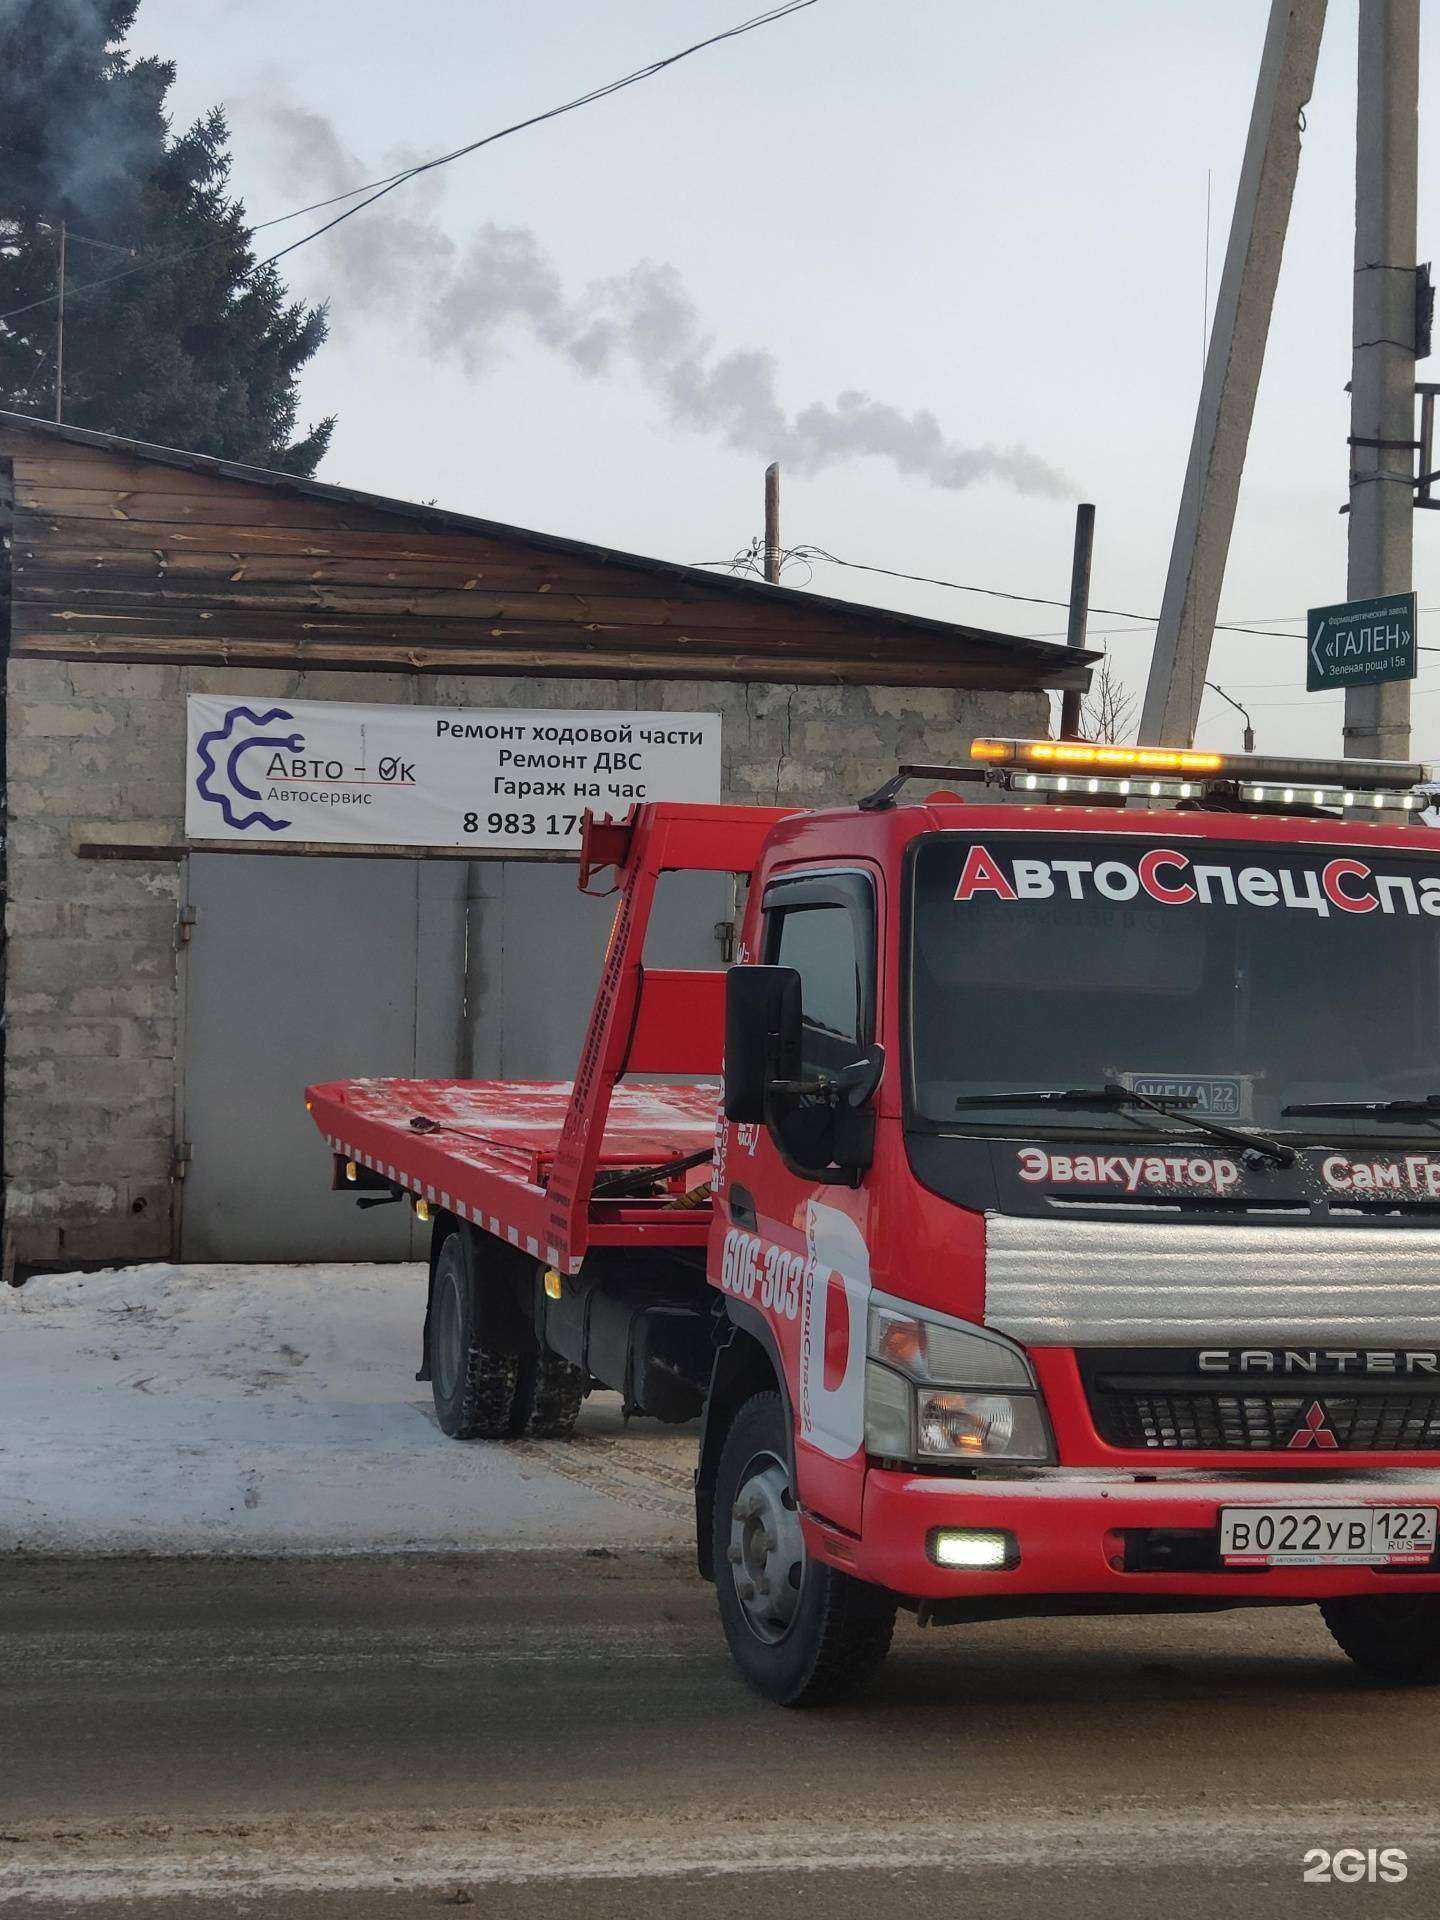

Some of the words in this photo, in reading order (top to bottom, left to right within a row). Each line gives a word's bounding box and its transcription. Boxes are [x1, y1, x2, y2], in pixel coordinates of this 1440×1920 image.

[1325, 623, 1411, 657] «ГАЛЕН»
[1365, 660, 1388, 675] роща
[436, 720, 526, 740] Ремонт
[532, 724, 632, 745] ходовой
[639, 730, 704, 745] части
[266, 752, 344, 779] Авто
[499, 749, 587, 769] Ремонт
[593, 752, 642, 773] ДВС
[267, 787, 373, 806] Автосервис
[494, 776, 566, 798] Гараж
[574, 784, 600, 797] на
[608, 784, 646, 798] час
[463, 812, 479, 833] 8
[487, 812, 536, 834] 983
[1214, 1087, 1233, 1103] 22
[1213, 1102, 1234, 1113] RUS
[1018, 1148, 1239, 1193] Эвакуатор
[721, 1228, 804, 1321] 606-303
[1198, 1350, 1440, 1373] CANTER
[1232, 1515, 1367, 1551] В022УВ
[1377, 1512, 1426, 1539] 122
[1387, 1540, 1413, 1550] RUS
